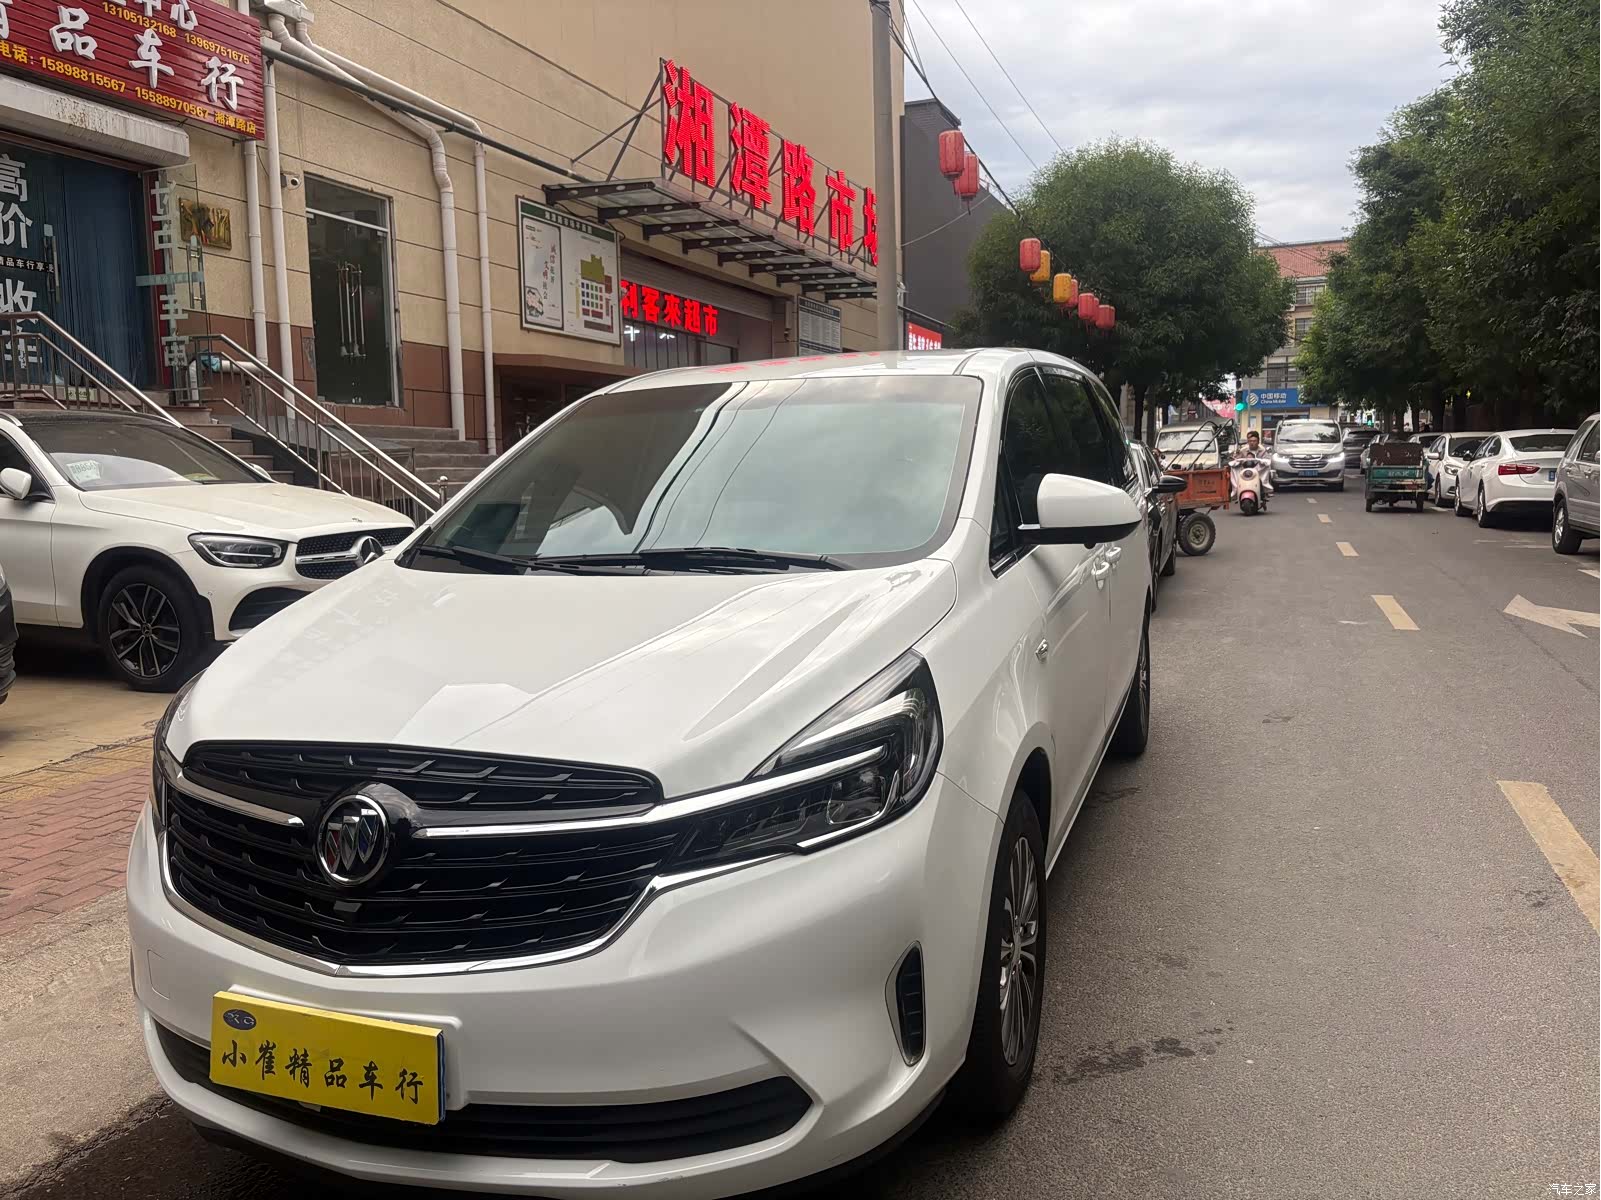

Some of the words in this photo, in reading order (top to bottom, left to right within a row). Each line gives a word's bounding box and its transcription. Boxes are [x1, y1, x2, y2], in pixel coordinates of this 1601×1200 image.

[102, 2, 177, 38] 13105132168
[184, 33, 250, 65] 13969751675
[39, 56, 126, 93] 15898815567
[134, 86, 209, 119] 15588970567
[214, 111, 256, 135] 湘潭路店
[222, 1040, 424, 1104] 小崔精品车行
